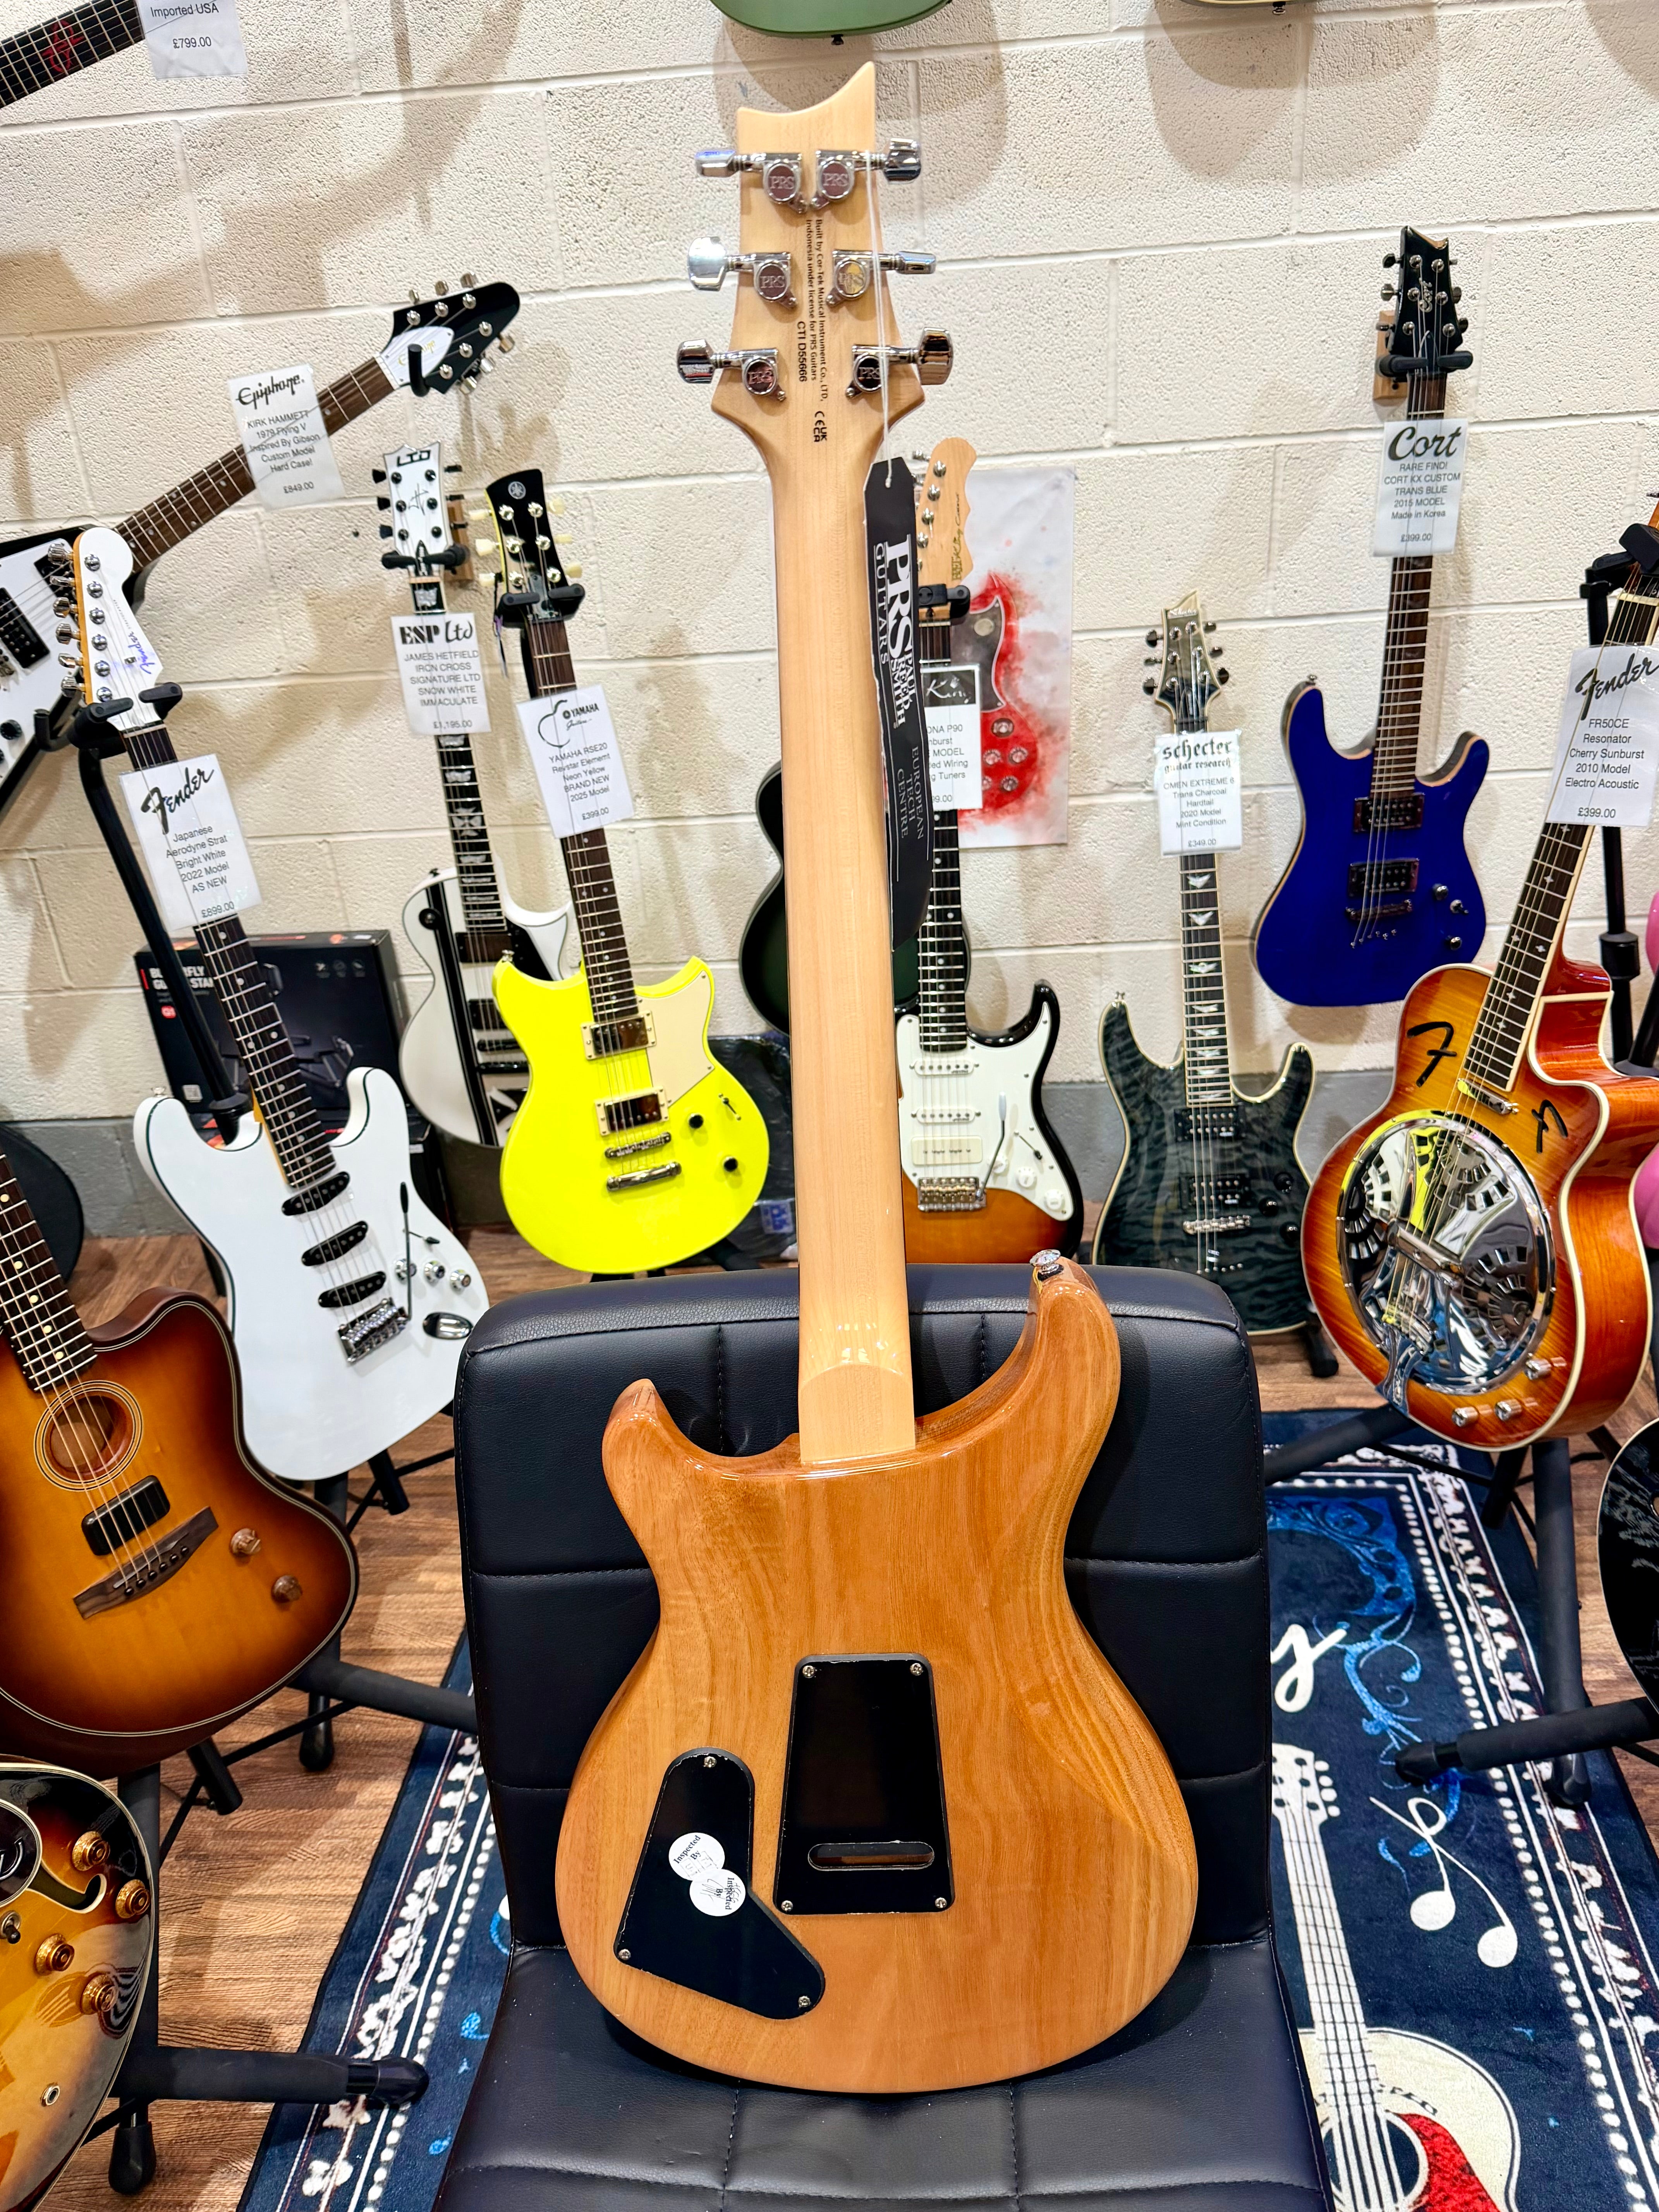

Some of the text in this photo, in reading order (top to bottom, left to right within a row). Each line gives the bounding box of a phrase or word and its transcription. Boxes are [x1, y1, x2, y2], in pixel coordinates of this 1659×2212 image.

[151, 3, 219, 19] Imported USA
[173, 36, 211, 48] £799.00
[769, 175, 794, 190] PRS
[823, 173, 848, 186] PRS
[815, 241, 823, 252] by
[759, 275, 785, 289] PRS
[797, 321, 807, 382] CTI D55666
[748, 371, 773, 385] PRS
[247, 410, 309, 429] KIRK HAMMETT
[256, 422, 306, 439] 1979 Flying V
[250, 434, 321, 452] Inspired By Gibson
[1388, 426, 1462, 461] Cort
[261, 445, 316, 462] Custom Model
[396, 450, 431, 467] LTD
[270, 458, 314, 472] Hard Case!
[1399, 461, 1448, 472] RARE FIND!
[1384, 472, 1461, 485] CORT KX CUSTOM
[283, 481, 314, 494] £849.00
[1395, 485, 1448, 496] TRANS BLUE
[1394, 497, 1445, 508] 2015 MODEL
[1391, 509, 1446, 520] Made in Korea
[1400, 533, 1432, 543] £399.00
[886, 534, 913, 659] PRS
[876, 543, 889, 665] GUITARS
[399, 624, 440, 645] ESP
[127, 631, 155, 675] Fender
[404, 650, 479, 662] JAMES HETFIELD
[415, 662, 472, 673] IRON CROSS
[410, 673, 481, 685] SIGNATURE LTD
[897, 655, 910, 711] REED
[905, 651, 916, 702] PAUL
[418, 685, 477, 696] SNOW WHITE
[891, 658, 906, 727] SMITH
[1575, 653, 1659, 721] Fender
[420, 696, 478, 706] IMMACULATE
[570, 702, 599, 718] YAMAHA
[927, 724, 963, 734] ONA P90
[1589, 718, 1630, 728] FR50CE
[929, 737, 953, 745] nburst
[1582, 733, 1632, 744] Resonator
[549, 742, 608, 763] YAMAHA RSE20
[933, 747, 964, 757] MODEL
[1162, 737, 1232, 762] schecter
[1569, 749, 1644, 760] Cherry Sunburst
[552, 761, 579, 774] Revstar
[943, 760, 968, 769] Wiring
[1575, 763, 1631, 774] 2010 Model
[563, 765, 605, 782] Neon Yellow
[938, 771, 966, 780] Tuners
[564, 775, 610, 793] BRAND NEW
[1163, 780, 1188, 790] OMEN
[1190, 777, 1228, 787] EXTREME
[1565, 777, 1639, 790] Electro Acoustic
[570, 786, 610, 802] 2025 Model
[906, 774, 916, 821] TECH
[912, 746, 924, 840] EUROPEAN
[1172, 787, 1227, 799] Trans Charcoal
[140, 767, 215, 835] Fender
[897, 768, 908, 838] CENTRE
[1186, 799, 1214, 807] Hardtail
[581, 807, 609, 820] £399.00
[1180, 807, 1221, 819] 2020 Model
[1577, 807, 1616, 819] £399.00
[1192, 818, 1226, 827] Condition
[173, 826, 213, 843] Japanese
[166, 835, 228, 859] Aerodyne Strat
[1188, 838, 1216, 848] £349.00
[176, 849, 226, 870] Bright White
[180, 861, 230, 883] 2022 Model
[192, 876, 228, 894] AS NEW
[201, 901, 235, 918] £899.00
[673, 1835, 701, 1864] Inspected
[690, 1850, 702, 1860] By
[725, 1877, 735, 1910] Inspected
